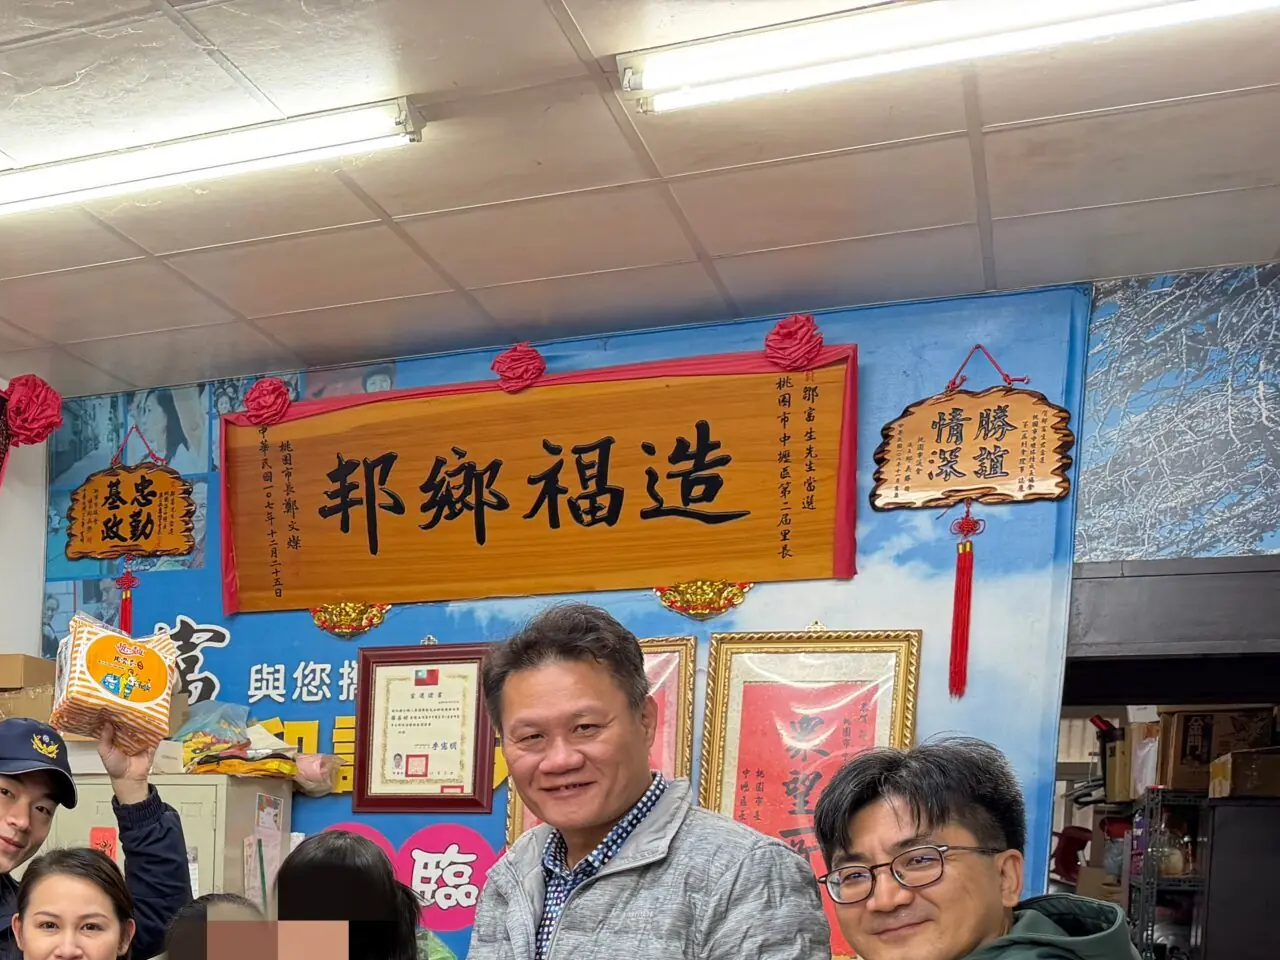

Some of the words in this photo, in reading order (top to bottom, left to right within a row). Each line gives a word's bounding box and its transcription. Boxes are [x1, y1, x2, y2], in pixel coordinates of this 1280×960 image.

[318, 420, 751, 555] 造福鄉邦
[411, 844, 480, 909] 臨
